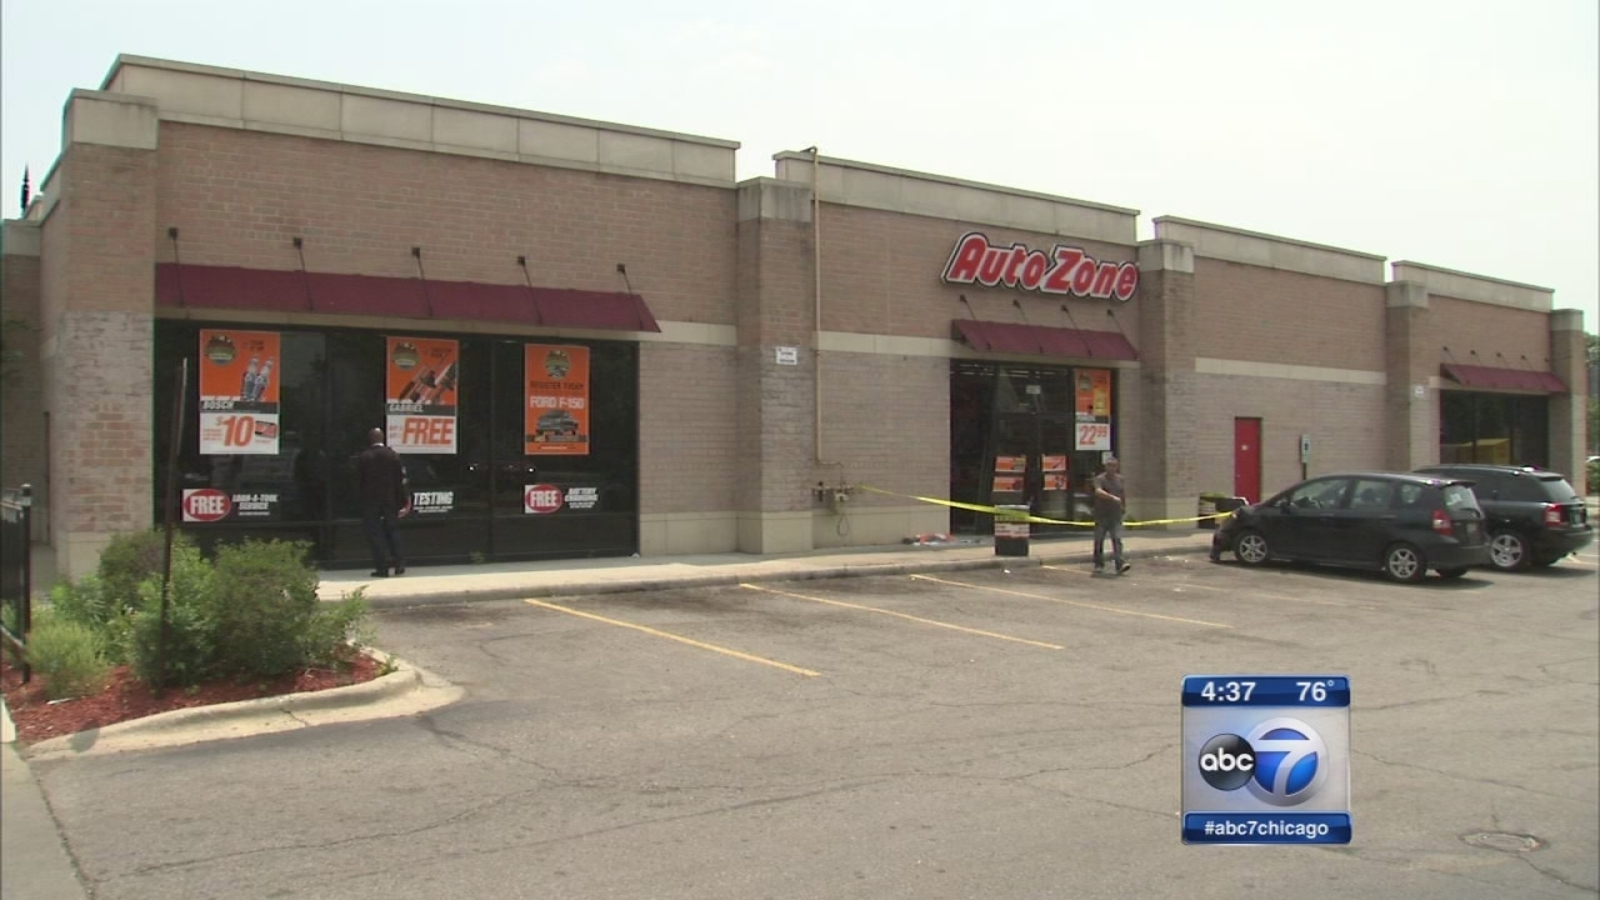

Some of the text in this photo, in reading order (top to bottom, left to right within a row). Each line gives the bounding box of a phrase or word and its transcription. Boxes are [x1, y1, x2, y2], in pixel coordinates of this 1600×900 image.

[942, 232, 1139, 301] AutoZone
[203, 401, 235, 410] BOSCH
[530, 396, 585, 409] FORD F-150
[402, 417, 454, 445] FREE
[190, 496, 225, 515] FREE
[413, 491, 454, 505] TESTING
[530, 490, 557, 507] FREE
